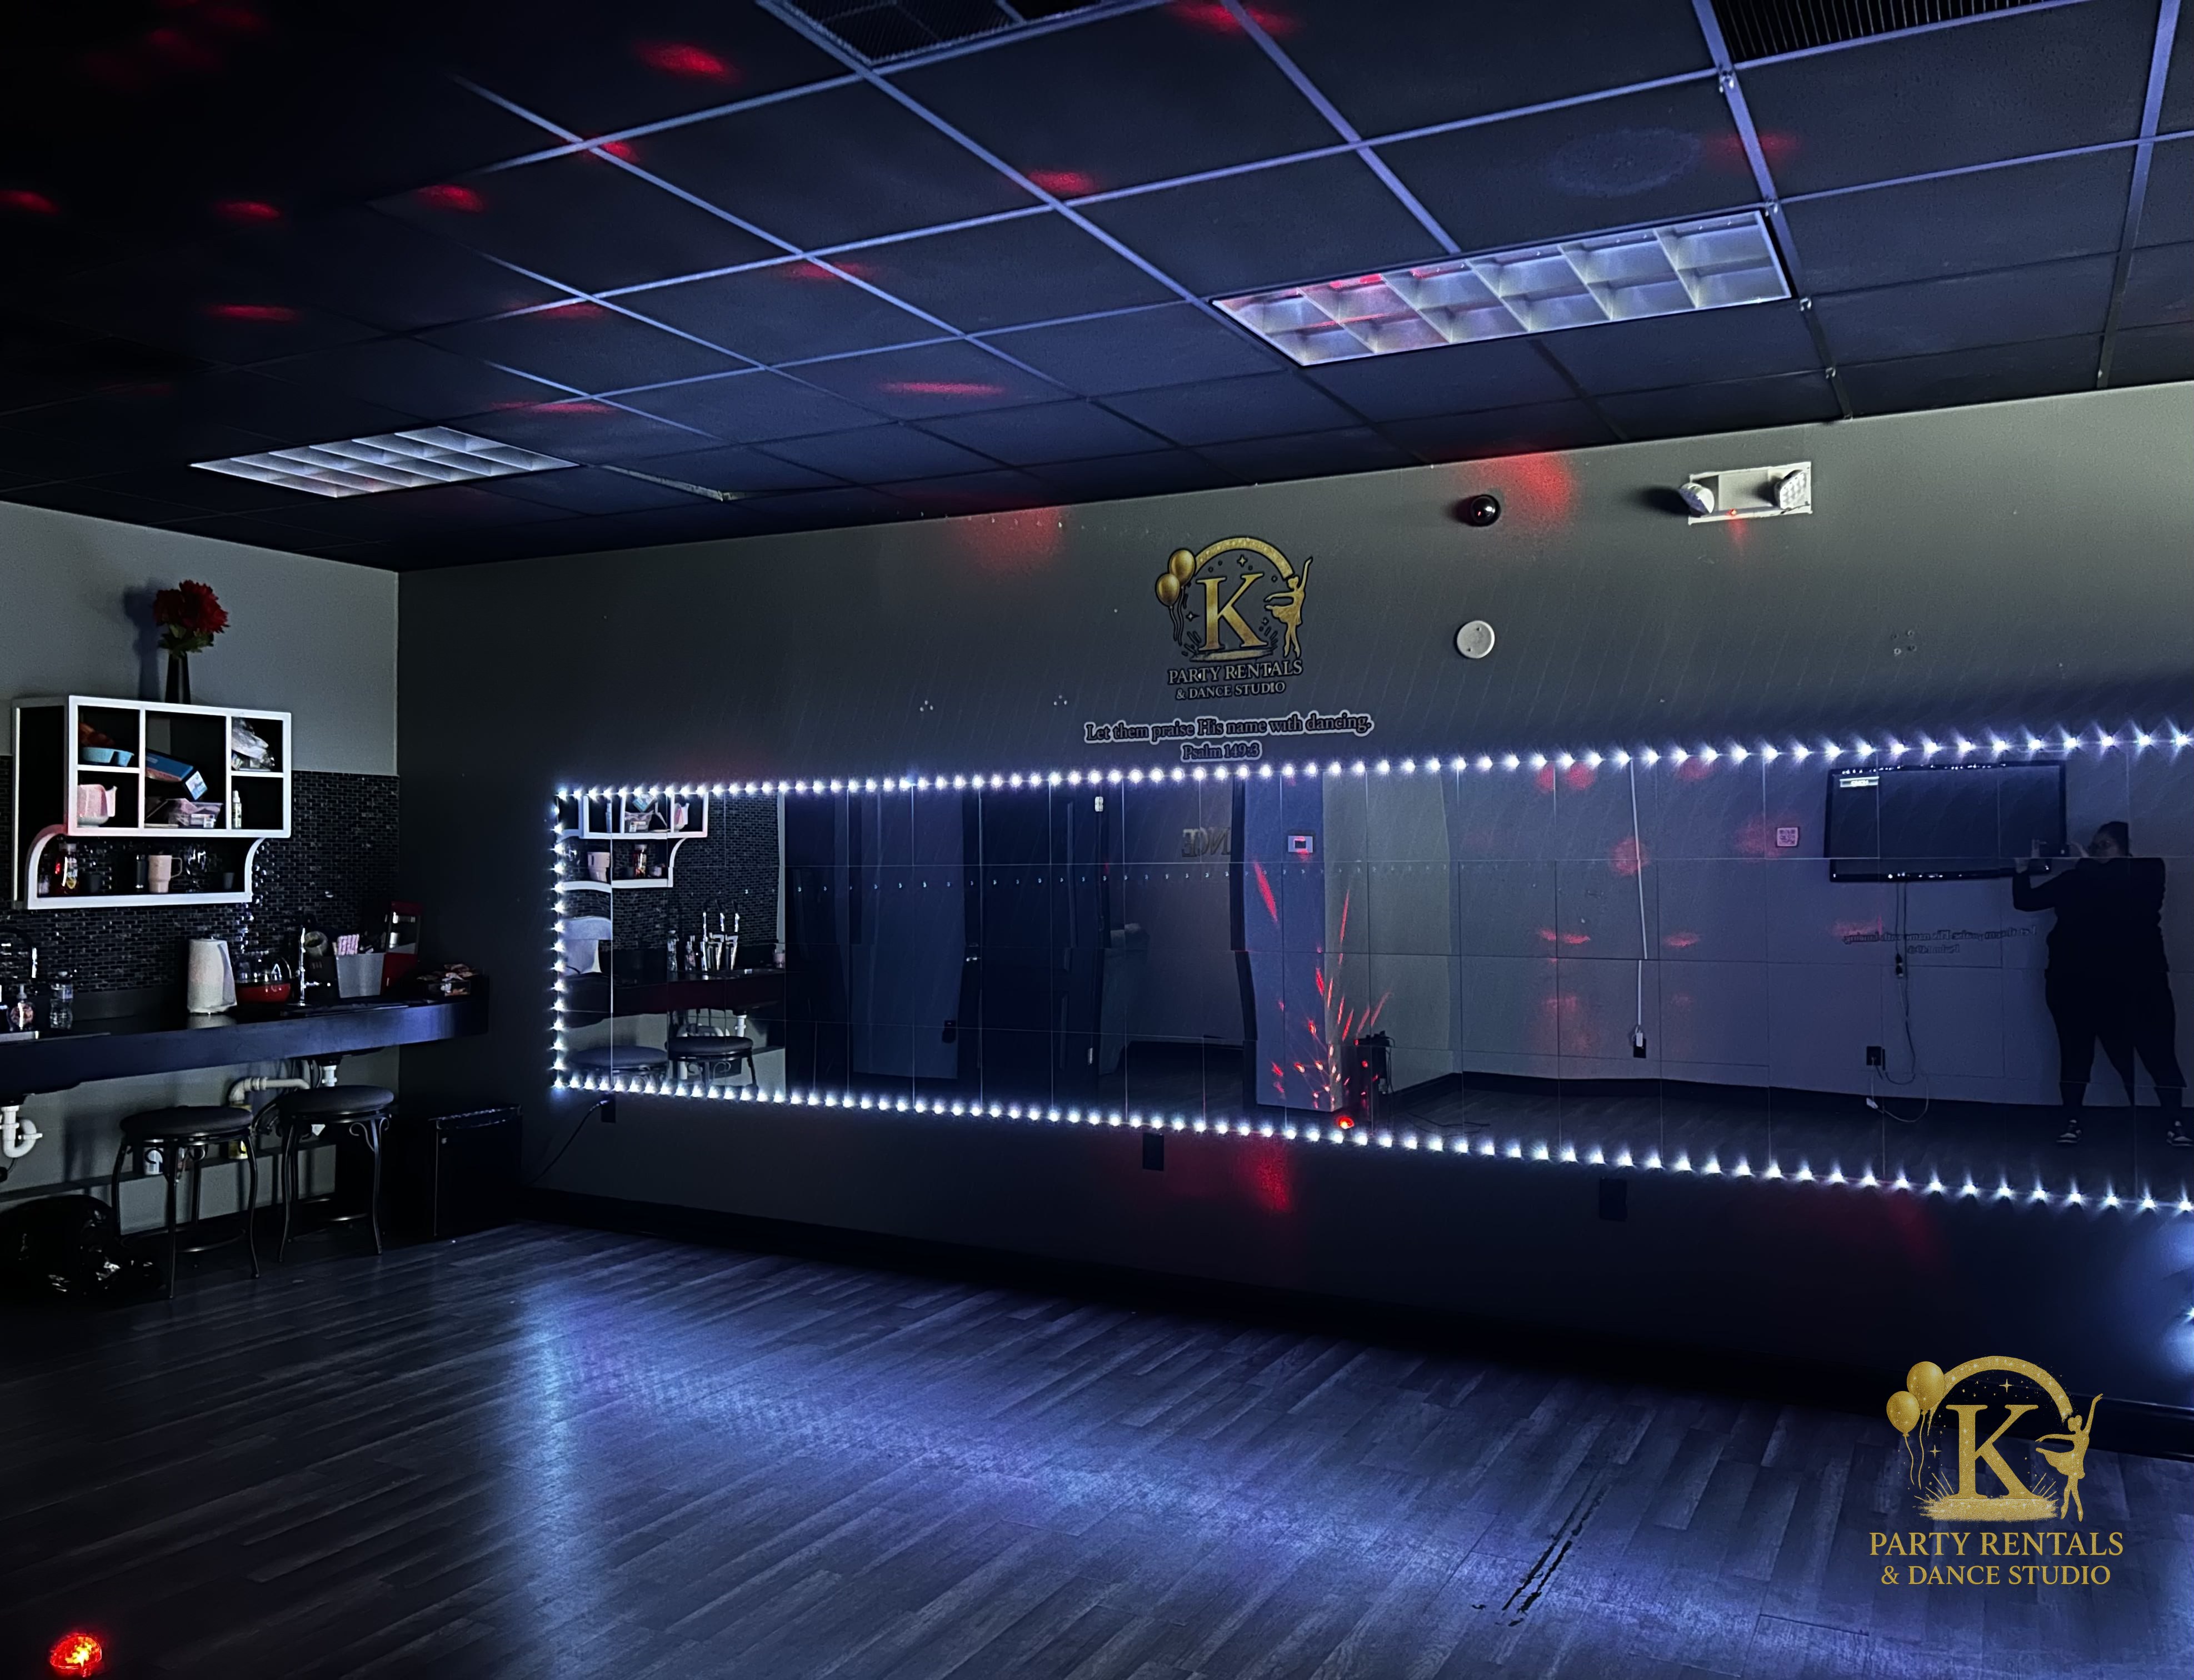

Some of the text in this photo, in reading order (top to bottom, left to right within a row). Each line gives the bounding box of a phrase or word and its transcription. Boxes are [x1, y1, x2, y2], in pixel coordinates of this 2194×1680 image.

[1196, 572, 1268, 651] K
[1168, 660, 1303, 684] PARTY RENTALS
[1176, 682, 1286, 699] & DANCE STUDIO
[1086, 712, 1373, 742] Let them praise His name with dancing.
[1182, 742, 1261, 760] Psalm 149:3
